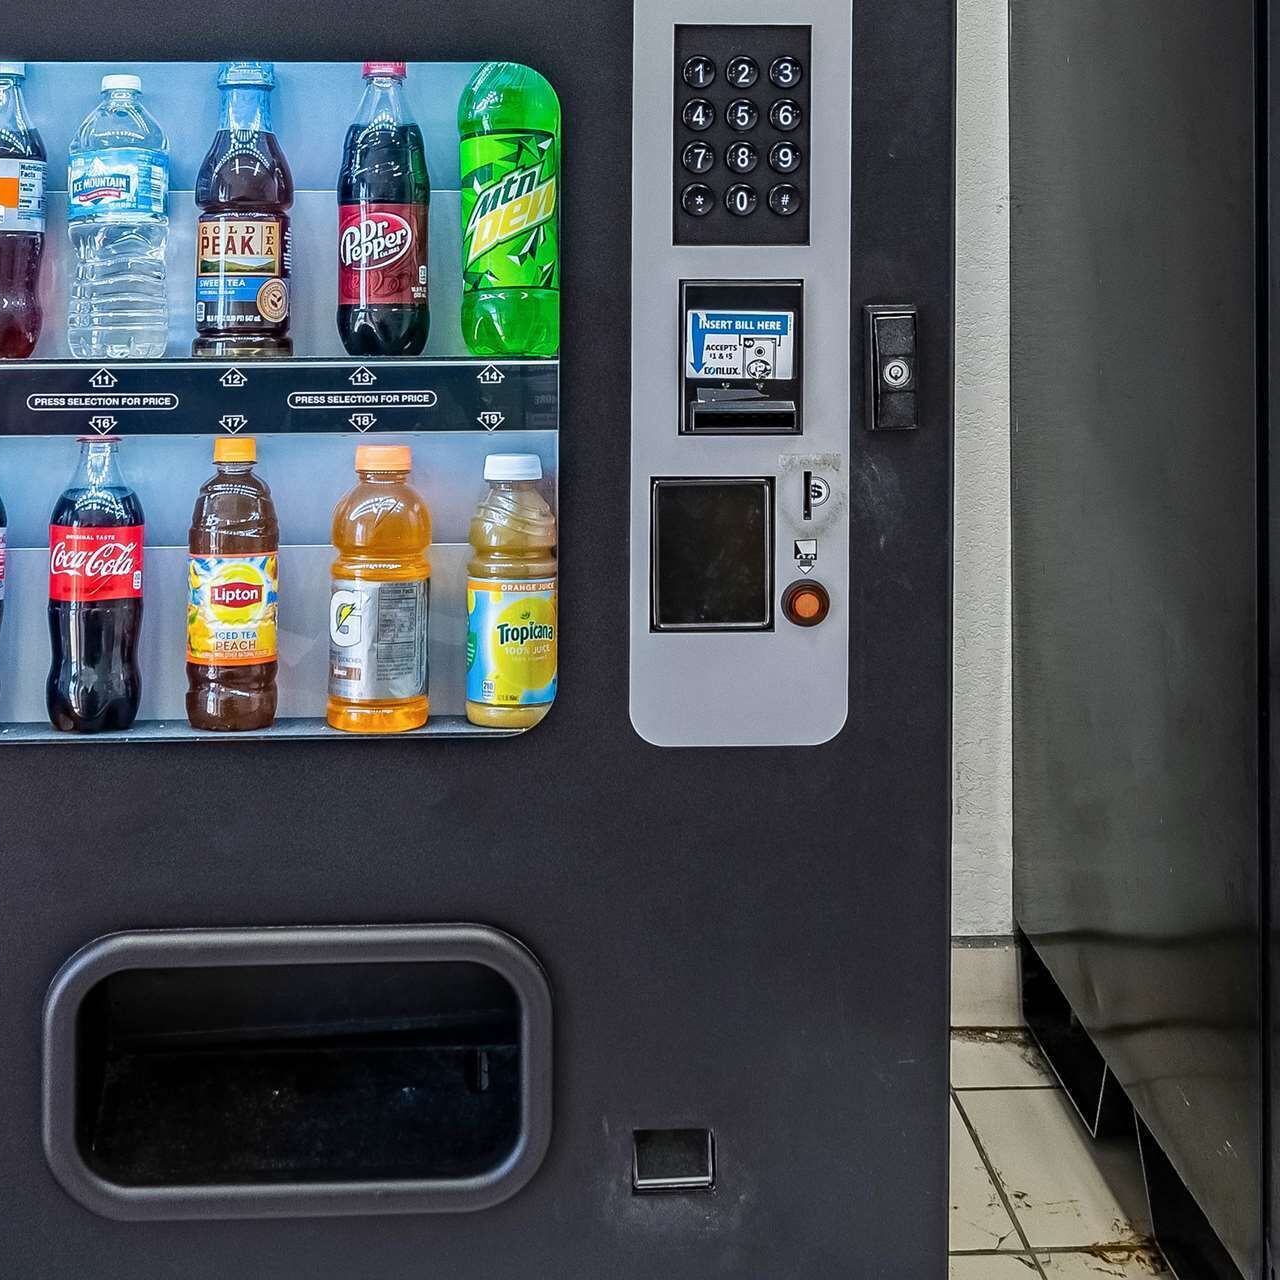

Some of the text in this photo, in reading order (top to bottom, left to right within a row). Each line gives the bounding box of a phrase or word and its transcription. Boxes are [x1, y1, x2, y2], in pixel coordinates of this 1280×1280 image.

[694, 63, 792, 83] 1 2 3
[692, 105, 792, 126] 4 5 6
[694, 147, 792, 169] 7 8 9
[84, 176, 126, 190] MOUNTAIN
[736, 191, 748, 212] 0
[201, 226, 256, 235] GOLD
[360, 220, 389, 243] Dr
[201, 235, 256, 256] PEAK
[344, 226, 408, 266] Pepper
[227, 279, 246, 287] TEA
[699, 319, 782, 330] INSERT BILL HERE
[705, 344, 738, 352] ACCEPTS
[96, 375, 110, 385] 11
[226, 374, 240, 384] 12
[356, 373, 369, 382] 13
[484, 372, 498, 381] 14
[35, 397, 171, 406] PRESS SELECTION FOR PRICE
[295, 394, 430, 404] PRESS SELECTION FOR PRICE
[96, 418, 110, 428] 16
[226, 417, 240, 427] 17
[356, 416, 369, 426] 18
[484, 414, 498, 424] 19
[51, 541, 137, 577] Coca-Cola
[501, 583, 536, 591] ORANGE
[213, 586, 259, 602] Lipton
[216, 631, 257, 640] ICED TEA
[497, 620, 553, 645] Tropicana
[216, 641, 256, 650] PEACH
[532, 644, 551, 655] JUICE
